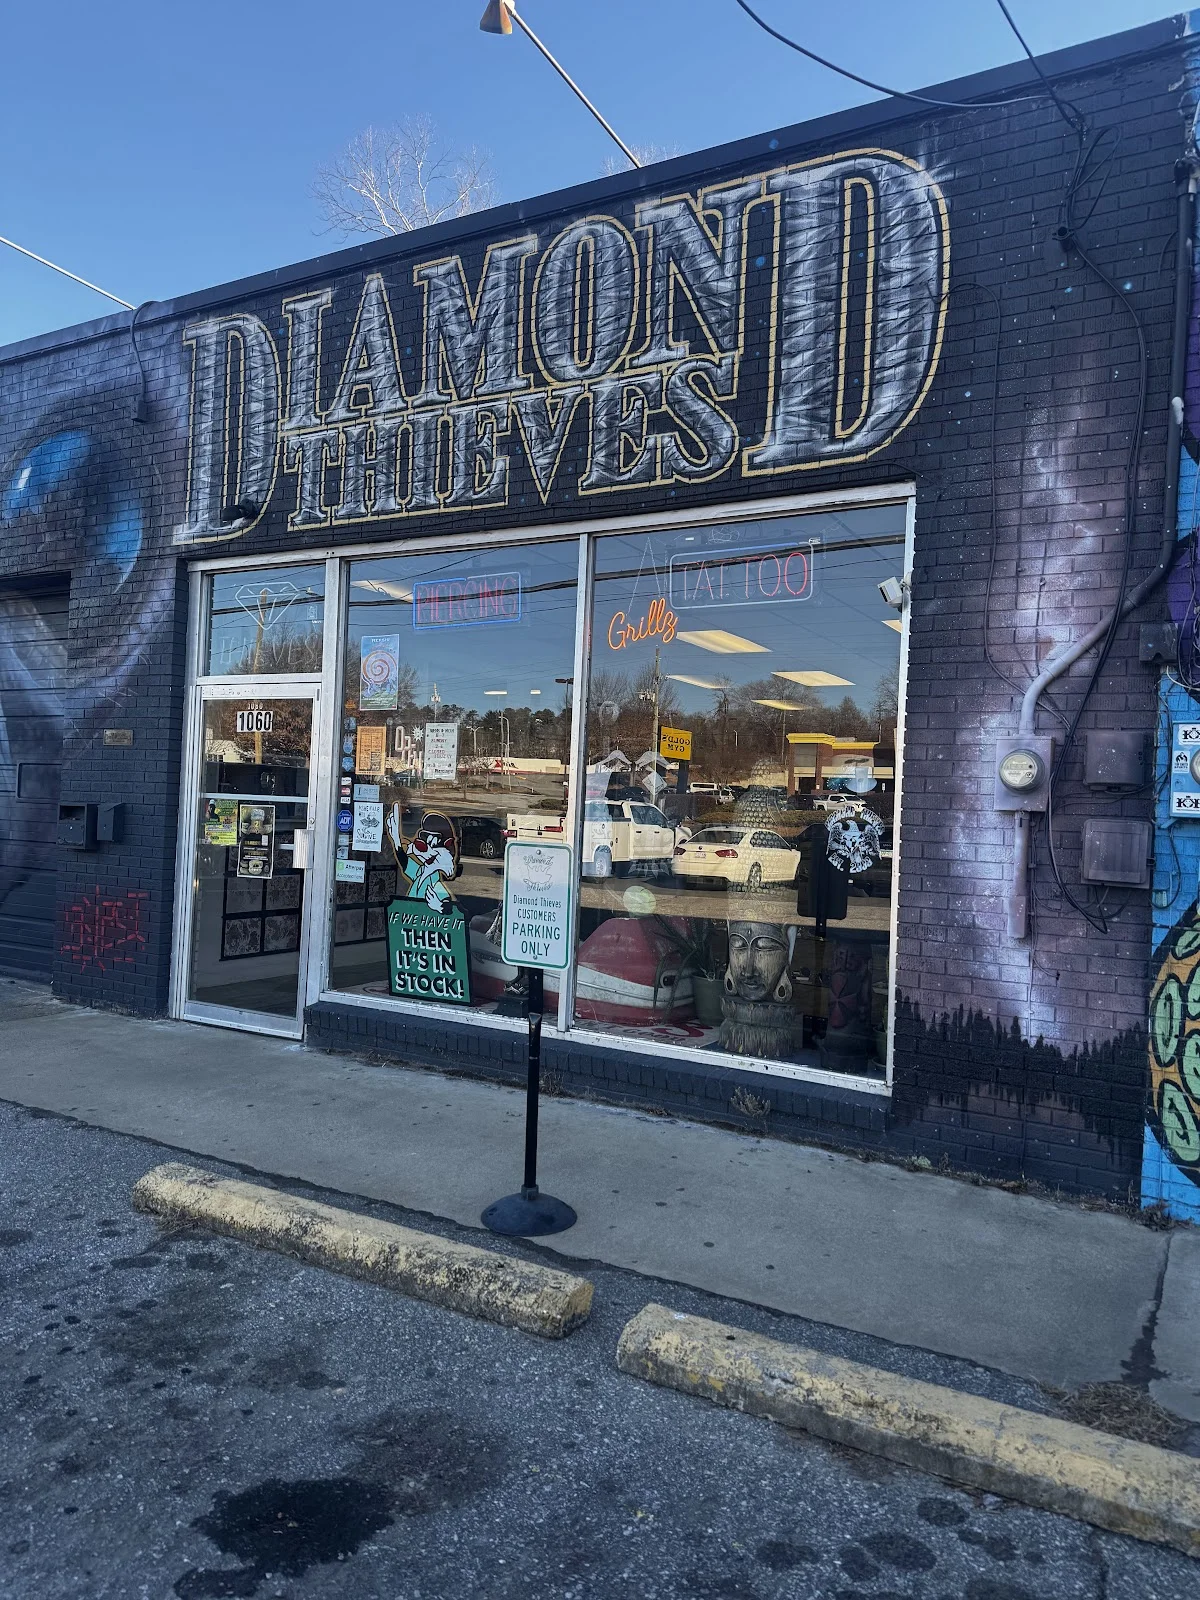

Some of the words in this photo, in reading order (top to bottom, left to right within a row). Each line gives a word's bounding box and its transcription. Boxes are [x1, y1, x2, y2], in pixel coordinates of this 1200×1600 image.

[173, 148, 951, 545] DIAMOND
[285, 352, 741, 532] THIEVES
[674, 553, 808, 600] TATTOO
[417, 577, 517, 623] PIERCING
[608, 597, 678, 650] Grillz
[239, 711, 272, 731] 1060
[339, 817, 351, 825] ADT
[513, 895, 538, 906] Diamond
[540, 897, 562, 909] Thieves
[389, 912, 400, 925] IF
[402, 913, 419, 927] WE
[420, 915, 450, 930] HAVE
[451, 918, 465, 930] IT
[517, 908, 556, 922] CUSTOMERS
[401, 928, 452, 952] THEN
[512, 922, 561, 940] PARKING
[521, 940, 550, 957] ONLY
[396, 950, 429, 971] IT'S
[433, 954, 456, 975] IN
[395, 971, 464, 999] STOCK!
